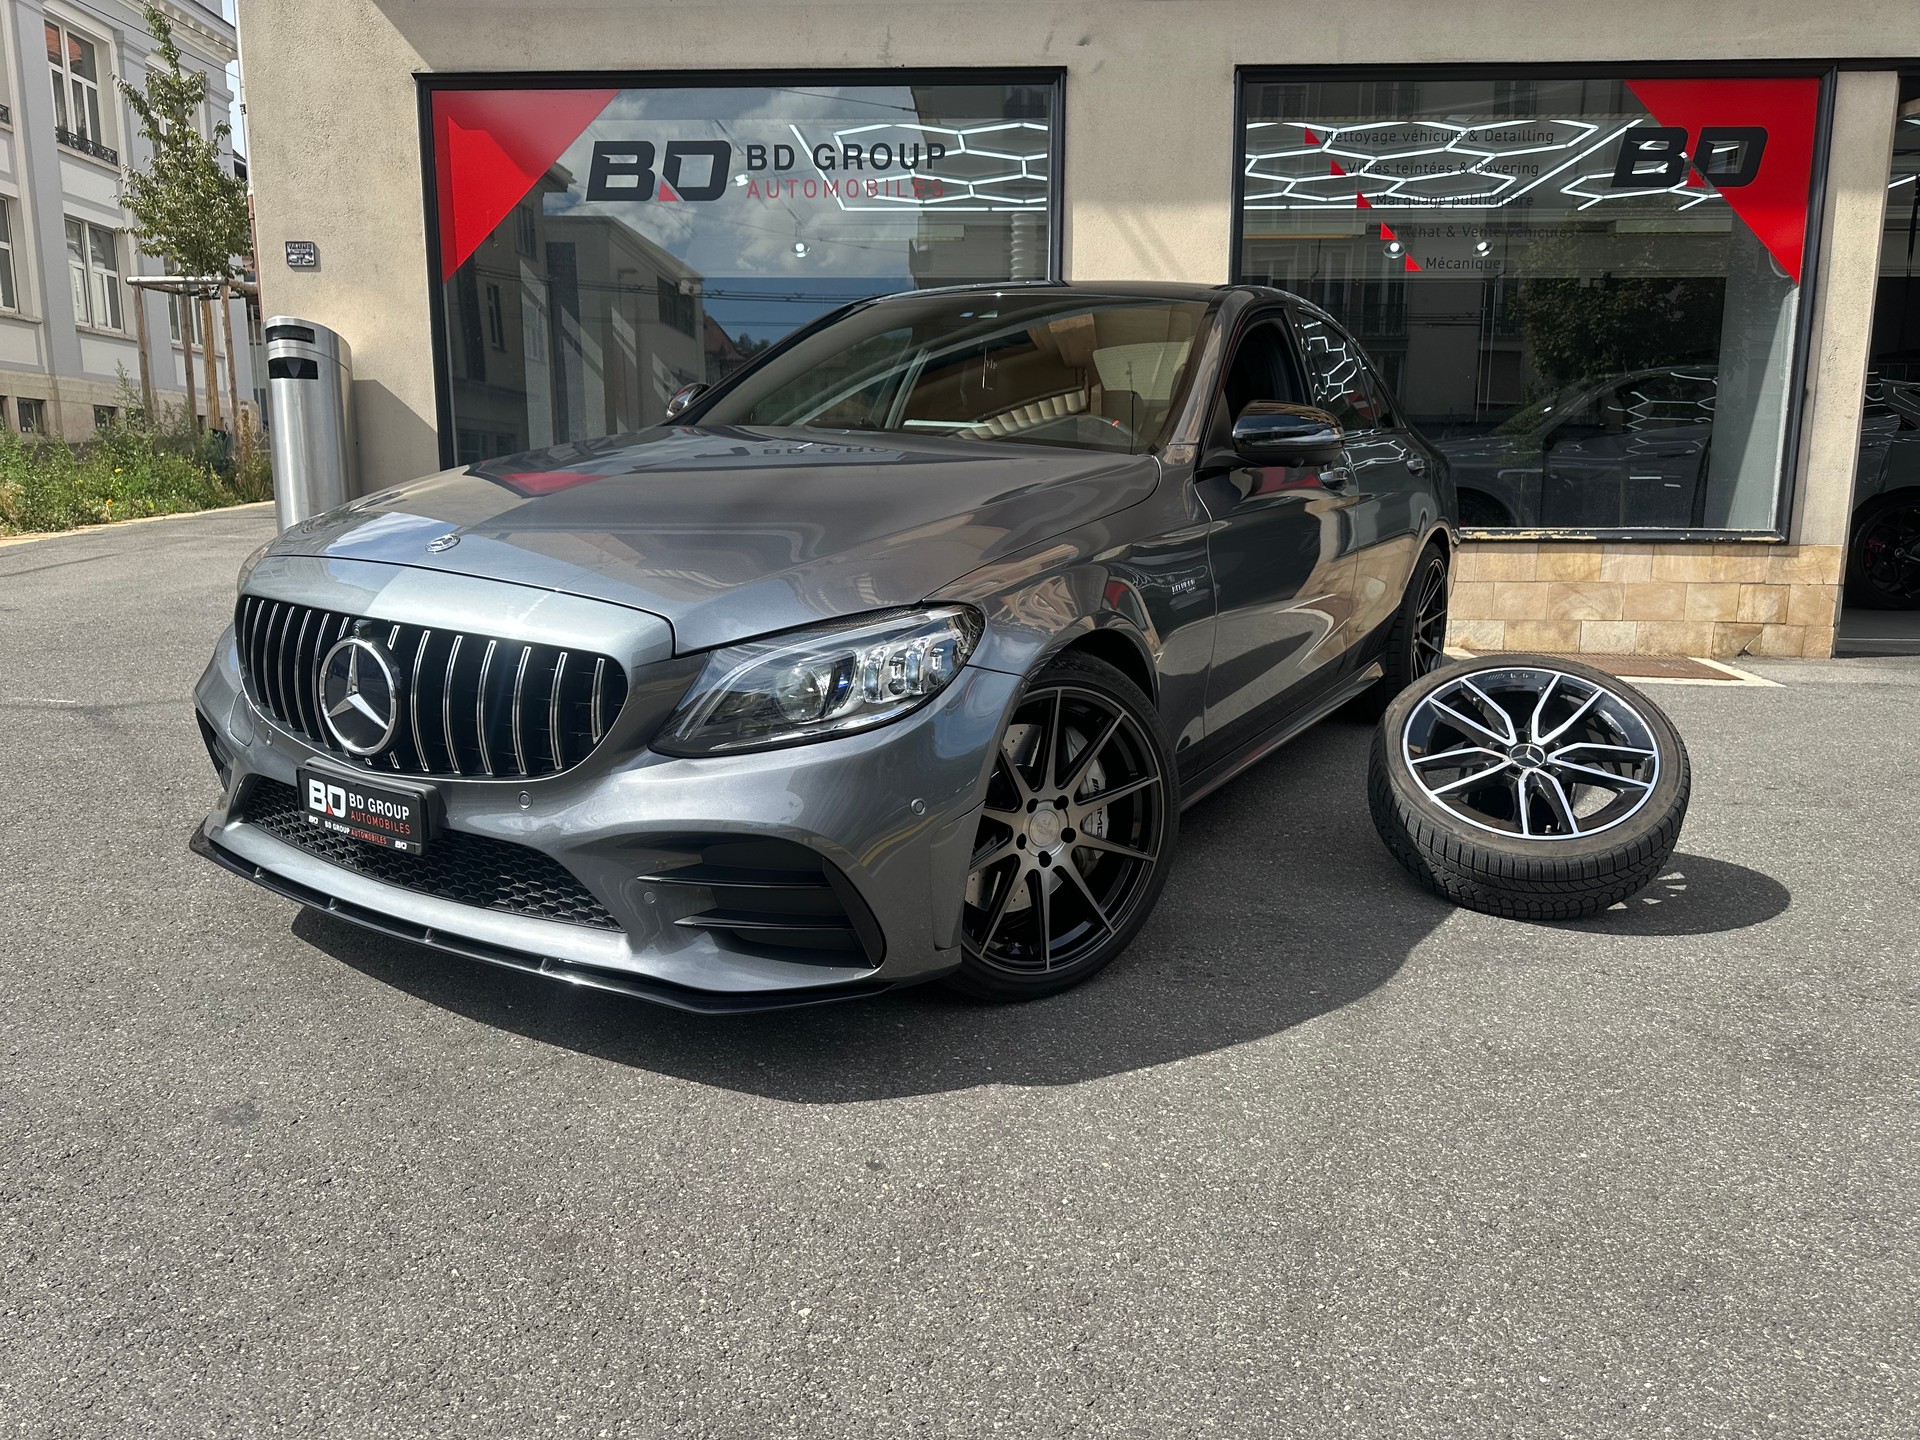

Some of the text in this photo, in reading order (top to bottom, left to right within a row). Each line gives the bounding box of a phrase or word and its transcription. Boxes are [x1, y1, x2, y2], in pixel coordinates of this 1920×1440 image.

[1325, 129, 1554, 145] Nettoyage véhicule & Detailling
[747, 143, 946, 171] BD GROUP
[1611, 126, 1768, 188] BD
[586, 140, 732, 202] BD
[1348, 161, 1539, 176] Vitres teintées & Covering
[747, 178, 945, 199] AUTOMOBILES
[1375, 194, 1446, 208] Marquage
[1446, 225, 1456, 238] &
[1462, 225, 1505, 238] Vente
[1426, 257, 1501, 271] Mécanique
[308, 778, 346, 818] BD
[348, 792, 410, 821] BD GROUP
[350, 810, 411, 835] AUTOMOBILES
[332, 823, 350, 835] GROUP
[351, 829, 387, 845] AUTOMOBILES
